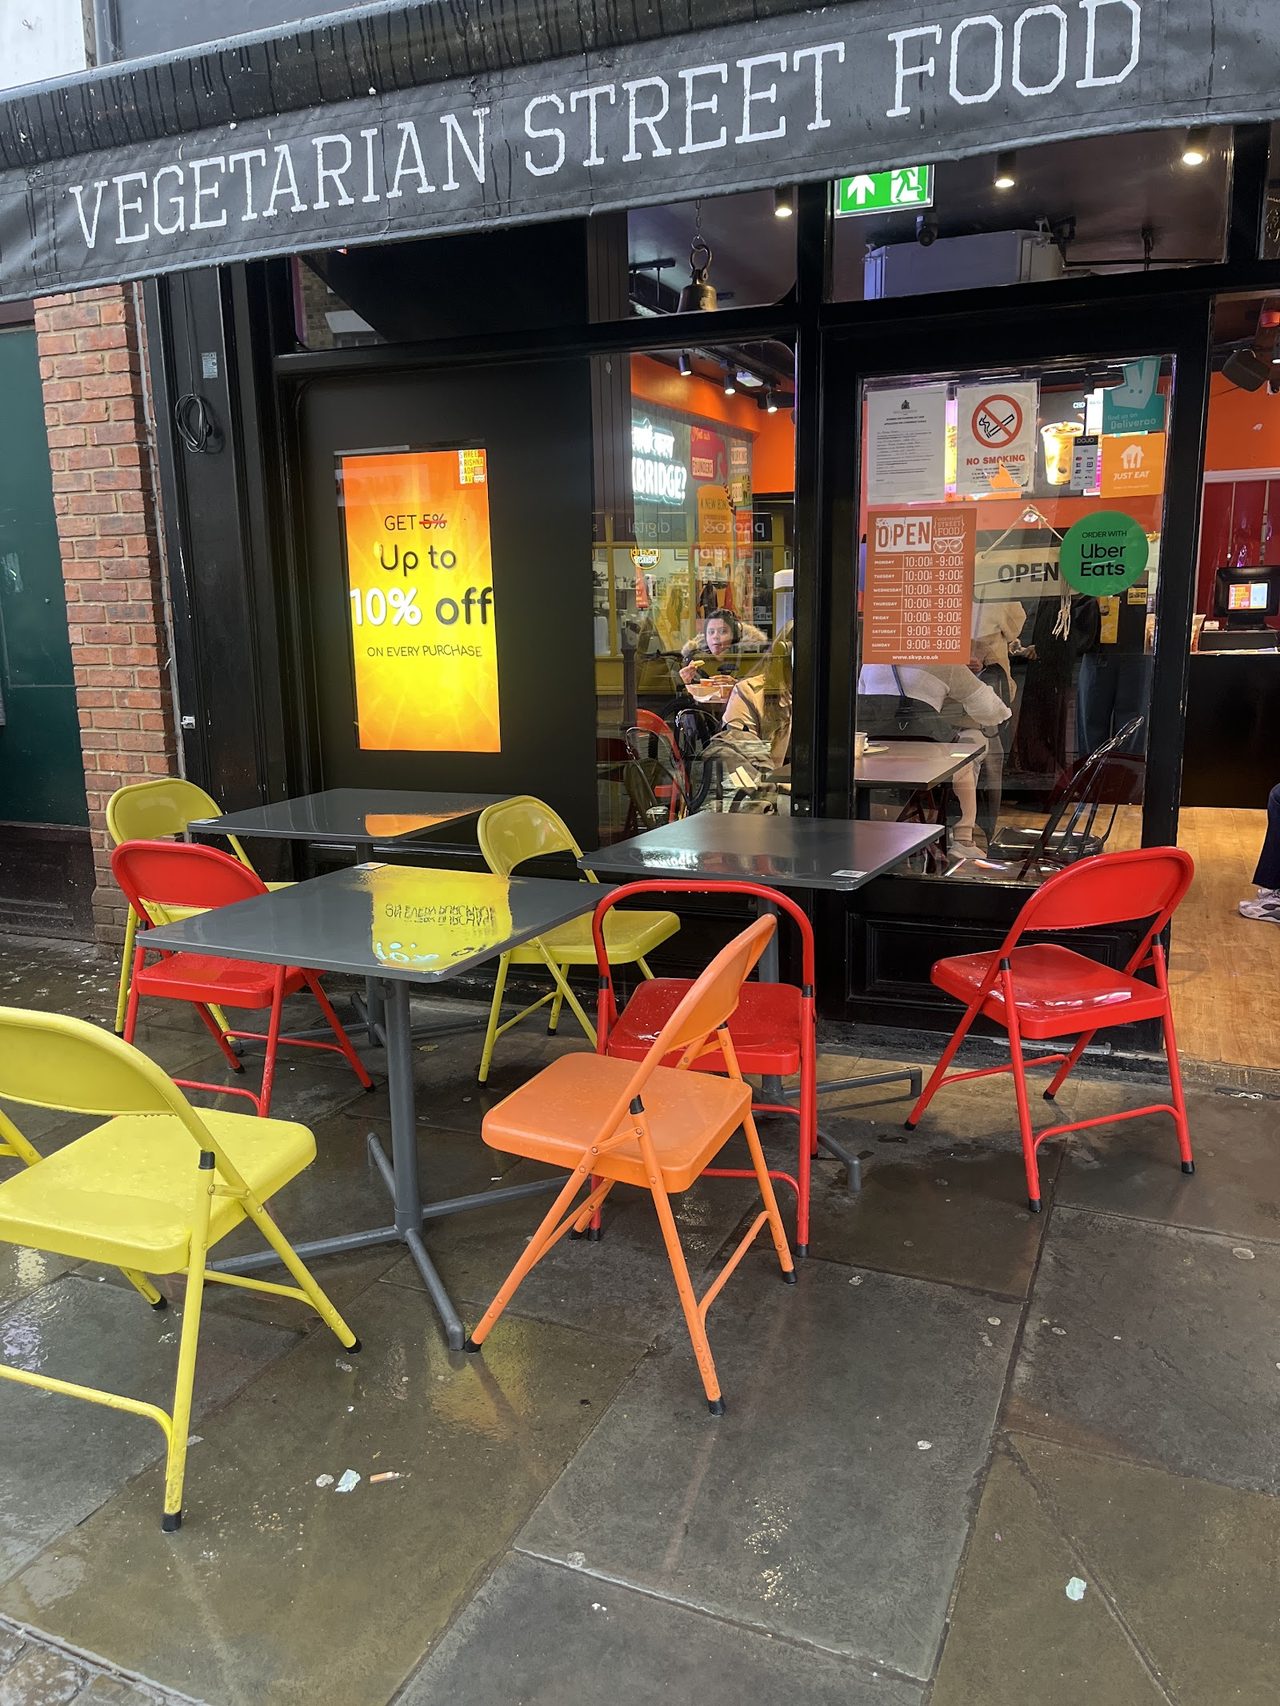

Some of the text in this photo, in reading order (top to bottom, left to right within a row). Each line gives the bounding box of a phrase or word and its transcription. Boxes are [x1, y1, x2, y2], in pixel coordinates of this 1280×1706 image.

[69, 0, 1142, 249] VEGETARIAN STREET FOOD
[966, 454, 1026, 466] NO SMOKING
[1113, 470, 1150, 480] JUST EAT
[384, 514, 417, 531] GET
[878, 521, 931, 548] OPEN
[938, 527, 960, 536] FOOD
[1082, 530, 1127, 539] ORDER WITH
[1080, 544, 1126, 559] Uber
[380, 544, 457, 577] Up to
[998, 562, 1060, 584] OPEN
[1080, 561, 1126, 577] Eats
[350, 586, 493, 626] 10% off
[367, 644, 483, 658] ON EVERY PURCHASE
